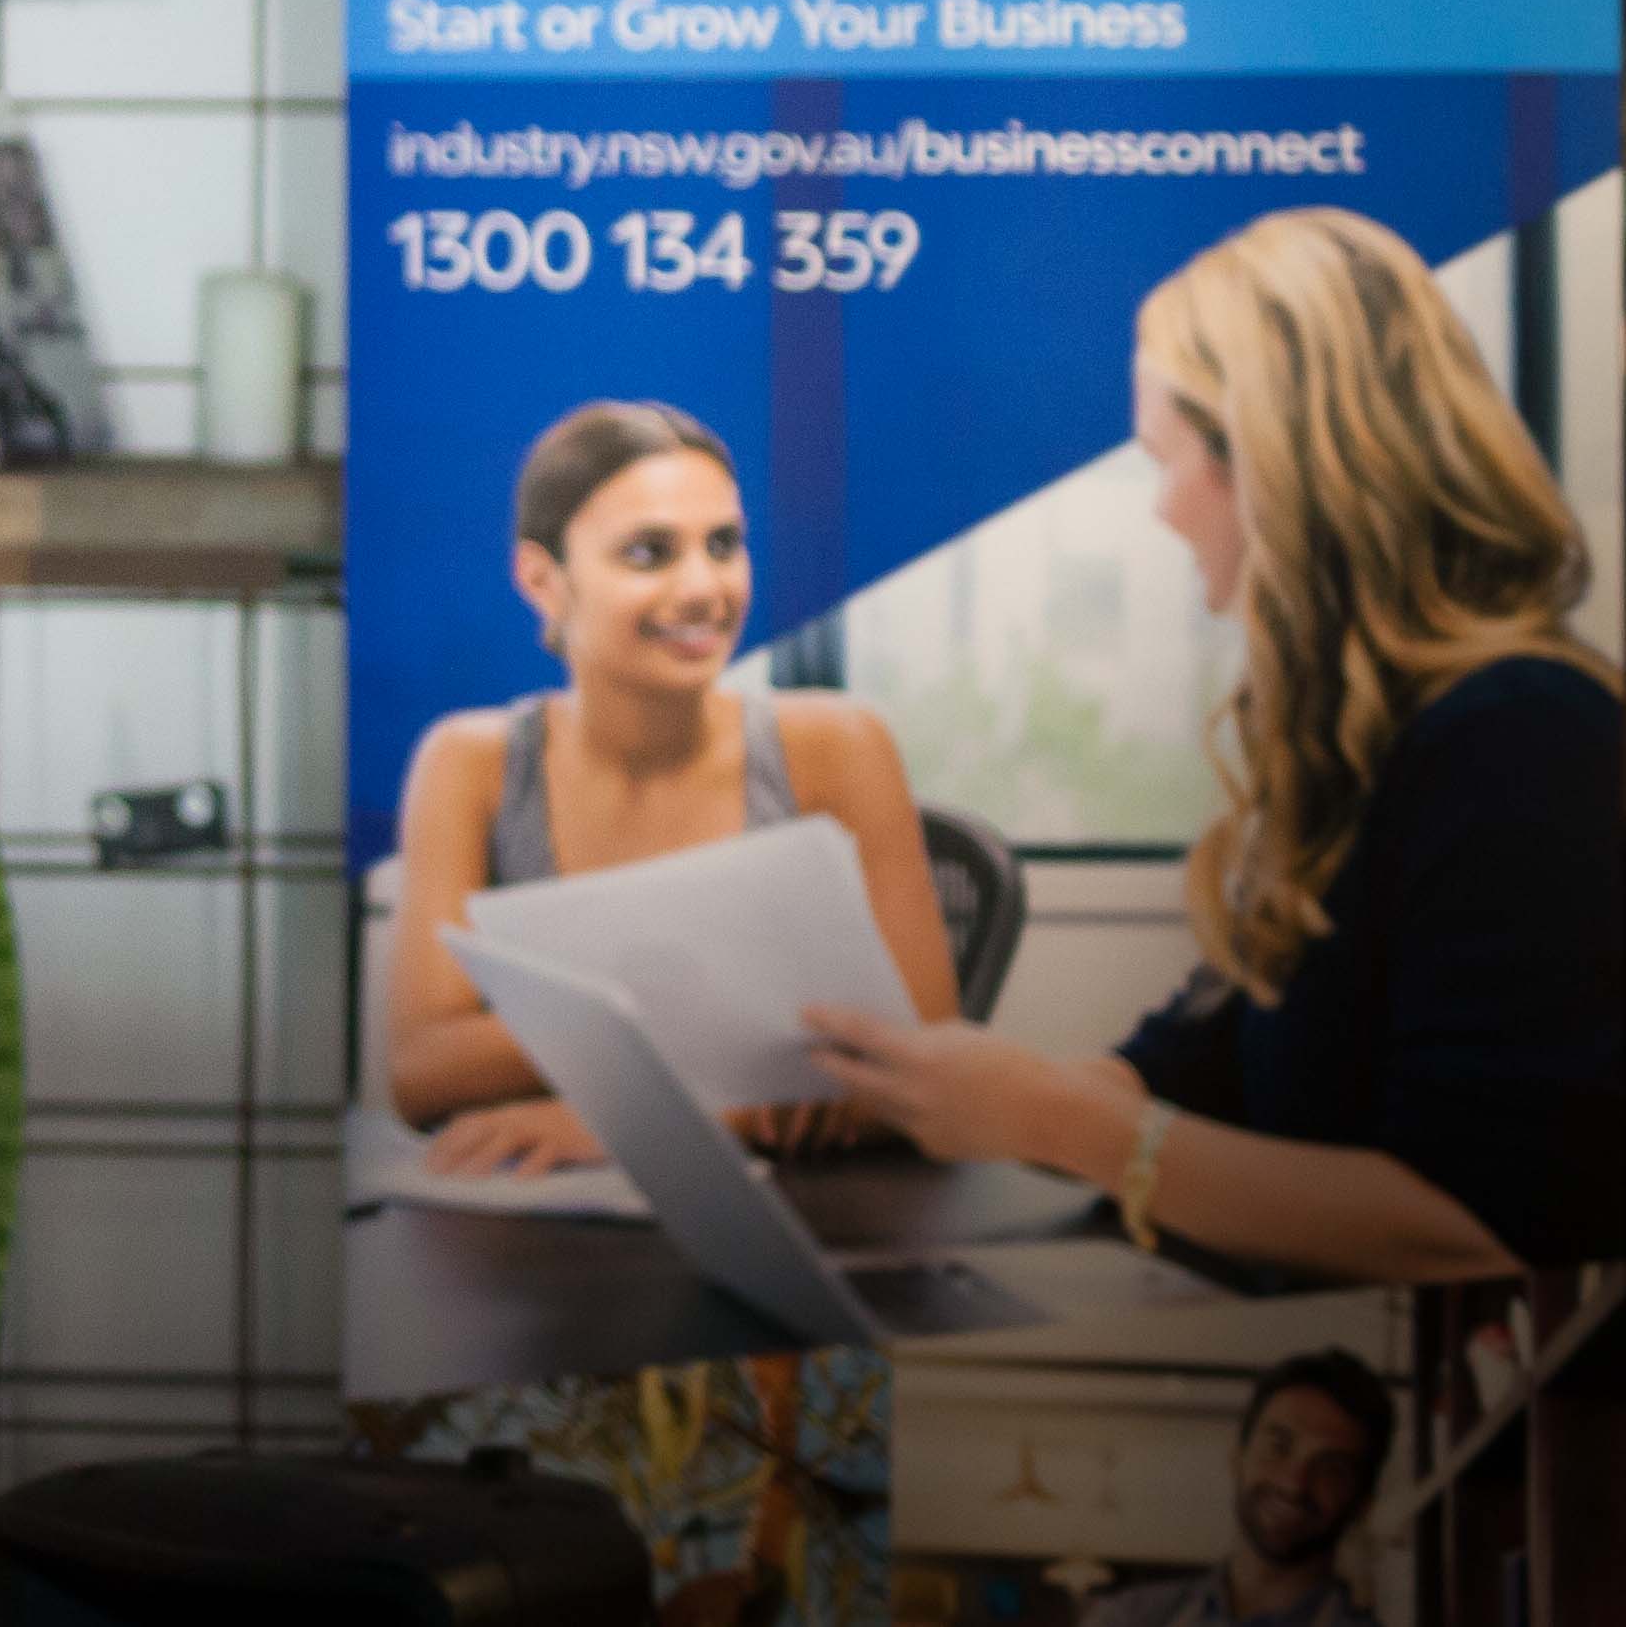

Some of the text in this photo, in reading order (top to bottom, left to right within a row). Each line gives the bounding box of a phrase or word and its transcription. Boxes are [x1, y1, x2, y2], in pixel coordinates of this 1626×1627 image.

[538, 3, 602, 51] or
[388, 118, 1366, 189] industry.nsw.gov.au/businessconnect
[388, 208, 920, 293] 1300 134 359
